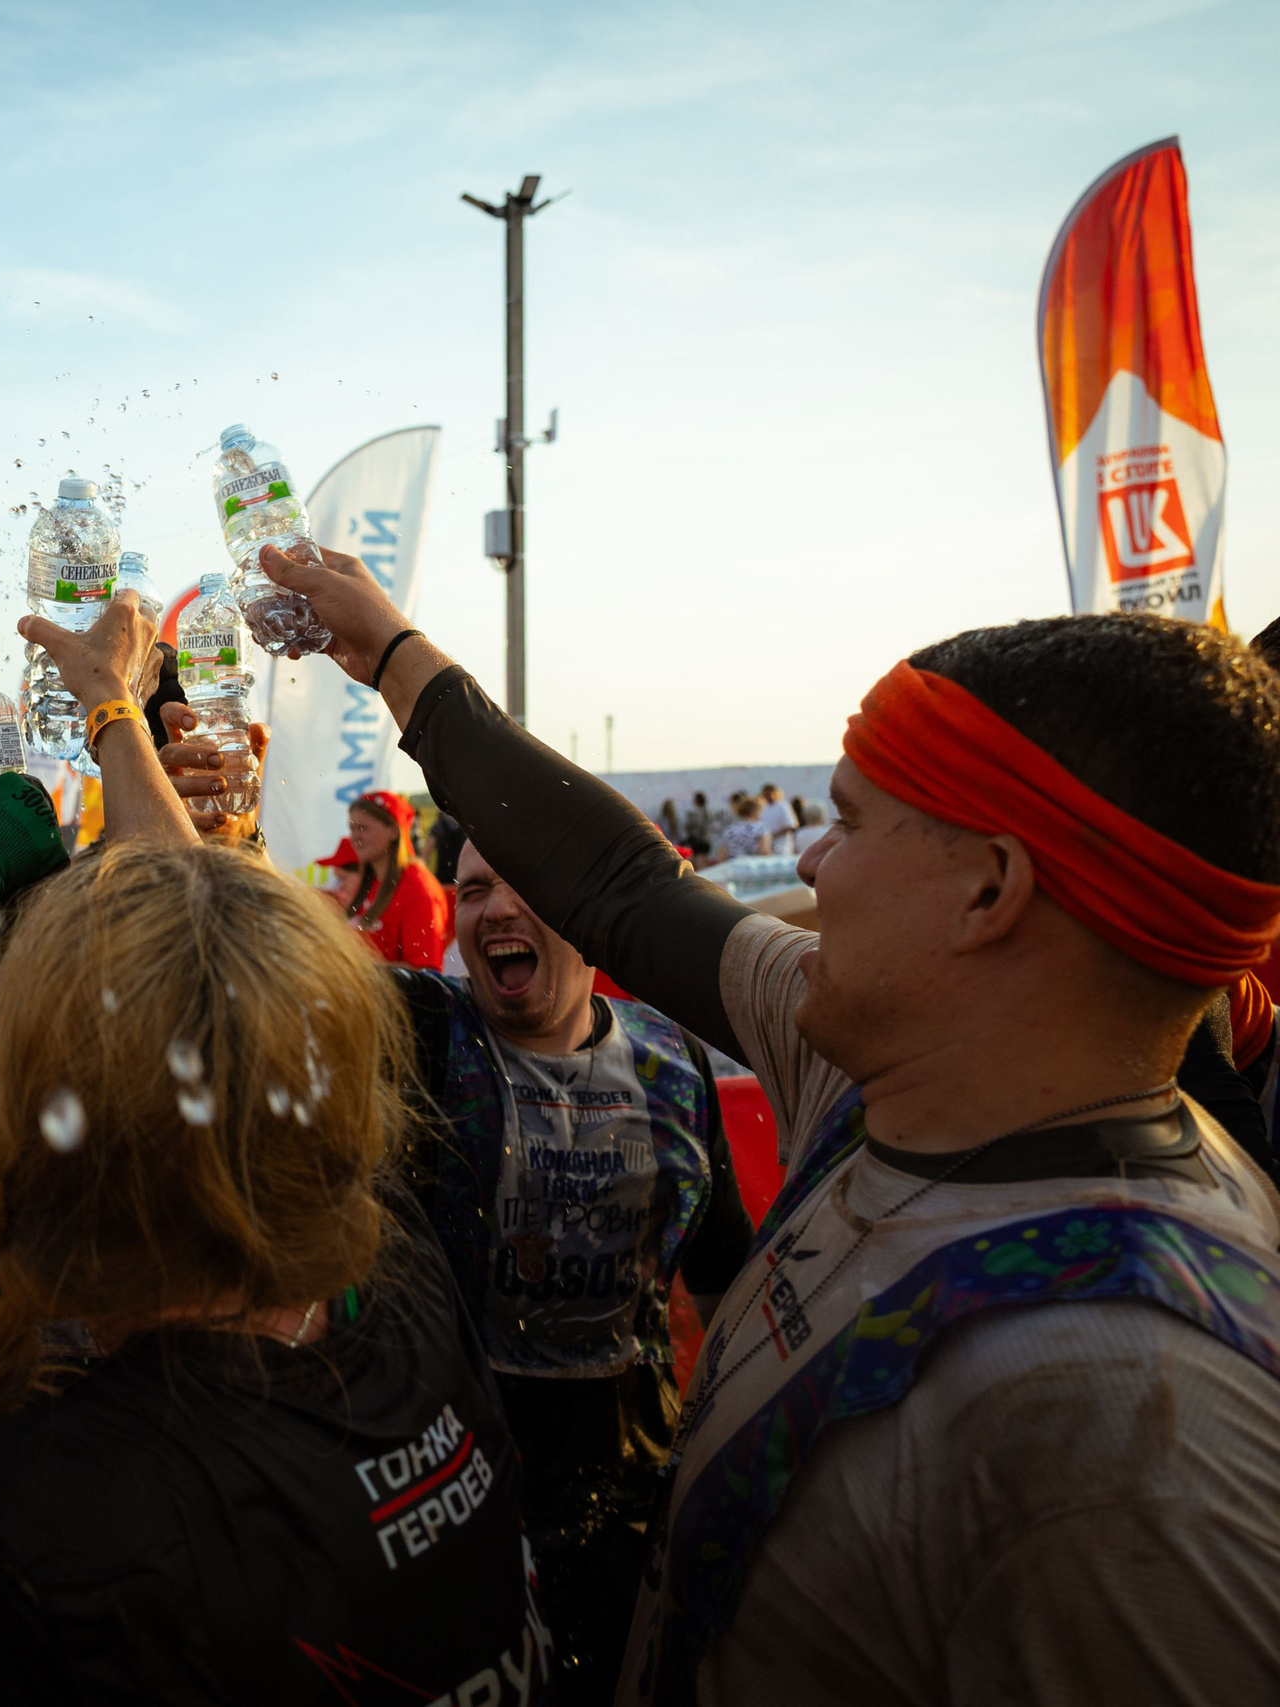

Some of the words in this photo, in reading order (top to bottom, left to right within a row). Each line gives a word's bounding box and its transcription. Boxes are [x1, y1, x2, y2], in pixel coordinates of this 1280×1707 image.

[221, 468, 282, 498] СЕНЕЖСКАЯ
[61, 562, 117, 580] СЕНЕЖСКАЯ
[180, 634, 234, 650] ЕНЕЖСКАЯ
[335, 510, 402, 804] АММИЙ
[529, 1146, 627, 1175] КОМАНДА
[355, 1404, 464, 1501] ГОНКА
[377, 1447, 494, 1570] ГЕРОЕВ
